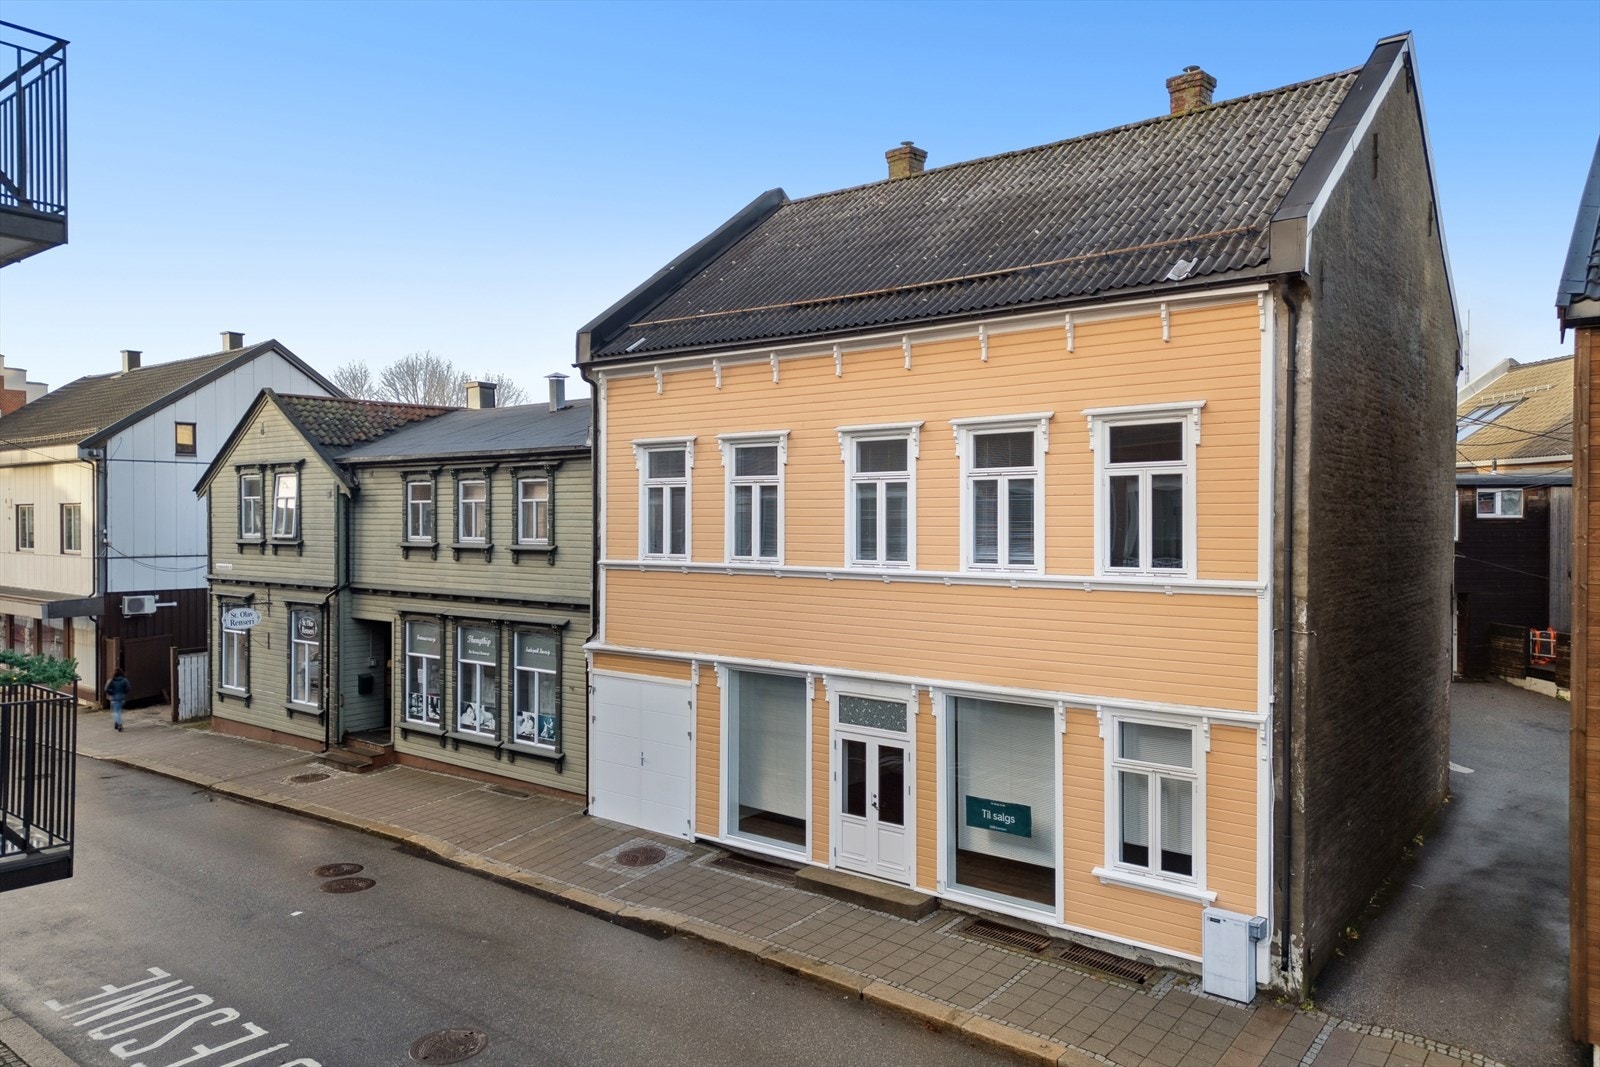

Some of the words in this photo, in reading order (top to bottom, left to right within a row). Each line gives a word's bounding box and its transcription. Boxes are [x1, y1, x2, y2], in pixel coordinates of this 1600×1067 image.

[240, 610, 253, 618] Olav
[230, 619, 255, 627] Renseri
[981, 808, 992, 820] Til
[992, 812, 1016, 825] salgs
